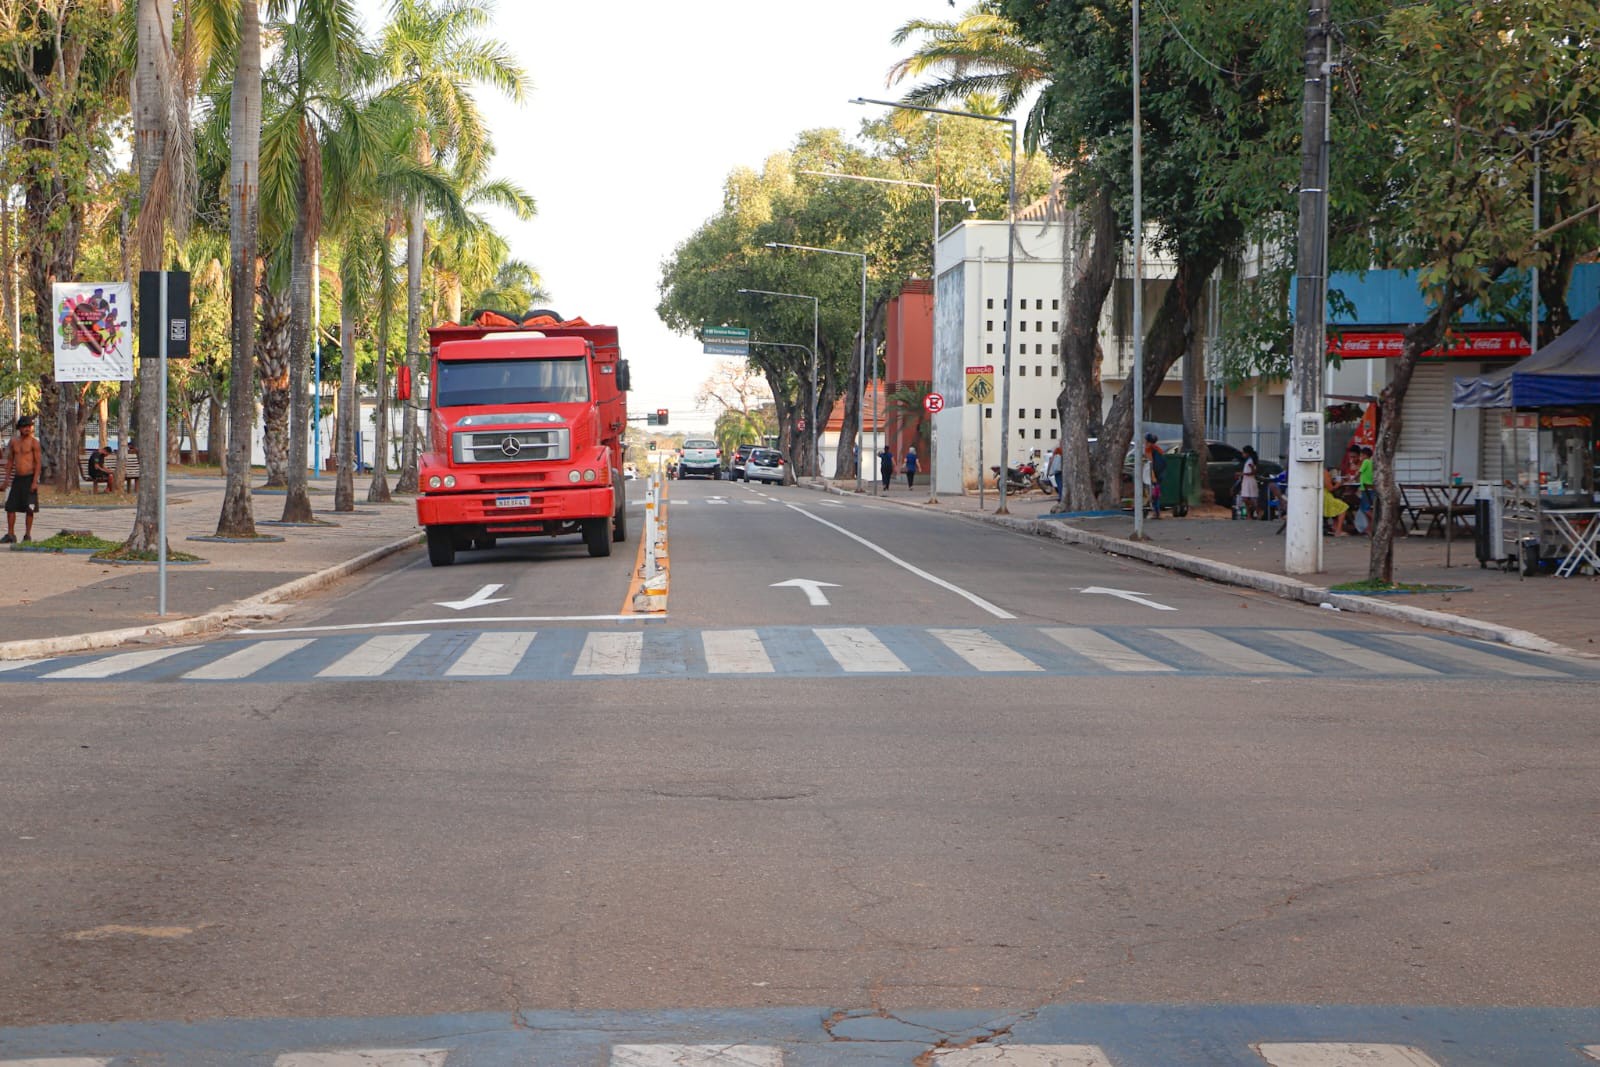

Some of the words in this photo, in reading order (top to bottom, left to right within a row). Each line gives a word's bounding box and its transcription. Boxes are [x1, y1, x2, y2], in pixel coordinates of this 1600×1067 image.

[1343, 339, 1370, 350] Coca-Cola
[1474, 338, 1502, 349] Coca-Cola
[967, 366, 992, 374] ATENÇÃO
